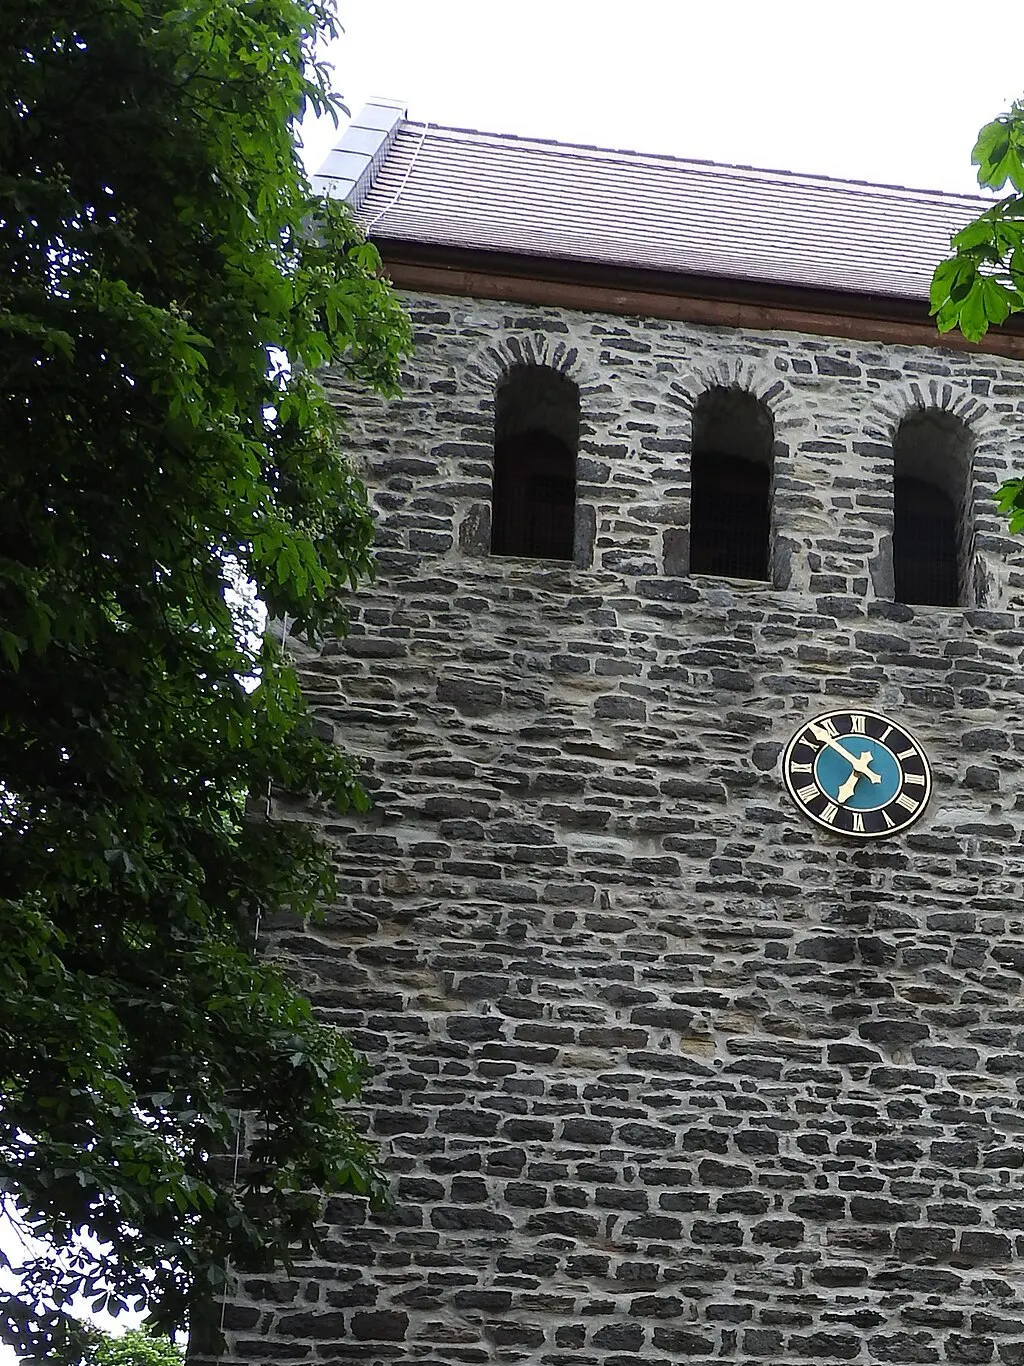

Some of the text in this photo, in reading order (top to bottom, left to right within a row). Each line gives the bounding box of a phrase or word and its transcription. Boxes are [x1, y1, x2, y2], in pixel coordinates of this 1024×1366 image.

[850, 715, 866, 733] XII
[879, 726, 893, 742] I
[799, 736, 819, 752] X
[897, 747, 917, 760] II
[791, 761, 812, 773] IX
[904, 773, 925, 786] III
[895, 793, 919, 813] IIII
[819, 802, 839, 823] VII
[882, 810, 895, 827] V
[852, 813, 865, 831] VI
